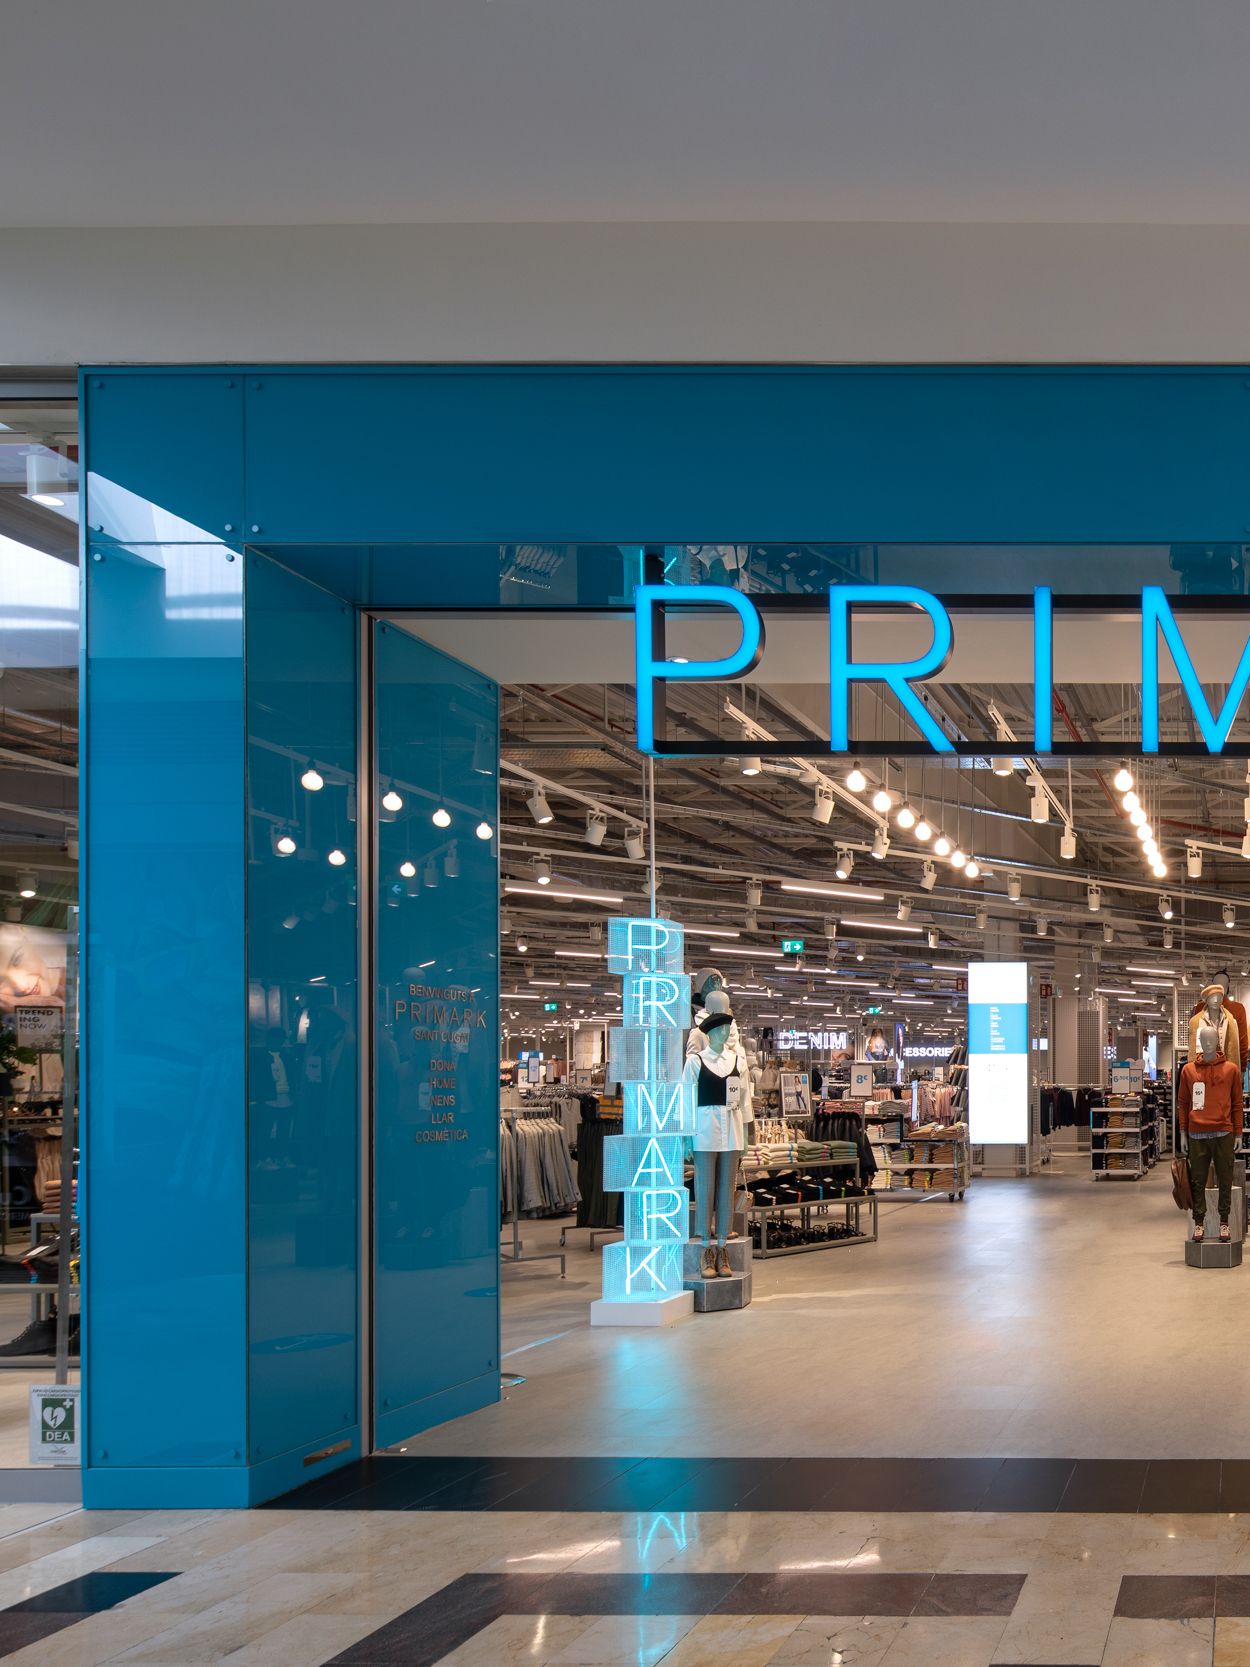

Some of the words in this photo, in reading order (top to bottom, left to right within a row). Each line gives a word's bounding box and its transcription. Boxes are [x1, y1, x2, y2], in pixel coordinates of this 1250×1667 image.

[409, 984, 467, 1002] BENVINGUTS
[395, 1000, 486, 1029] PRIMARK
[415, 1030, 439, 1041] SANT
[779, 1031, 847, 1050] DENIM
[430, 1059, 456, 1072] DONA
[430, 1078, 456, 1089] HOME
[856, 1074, 868, 1084] 8€
[430, 1095, 456, 1107] NENS
[625, 921, 684, 1296] PRIMARK
[431, 1113, 454, 1124] LLAR
[46, 1431, 70, 1441] DEA
